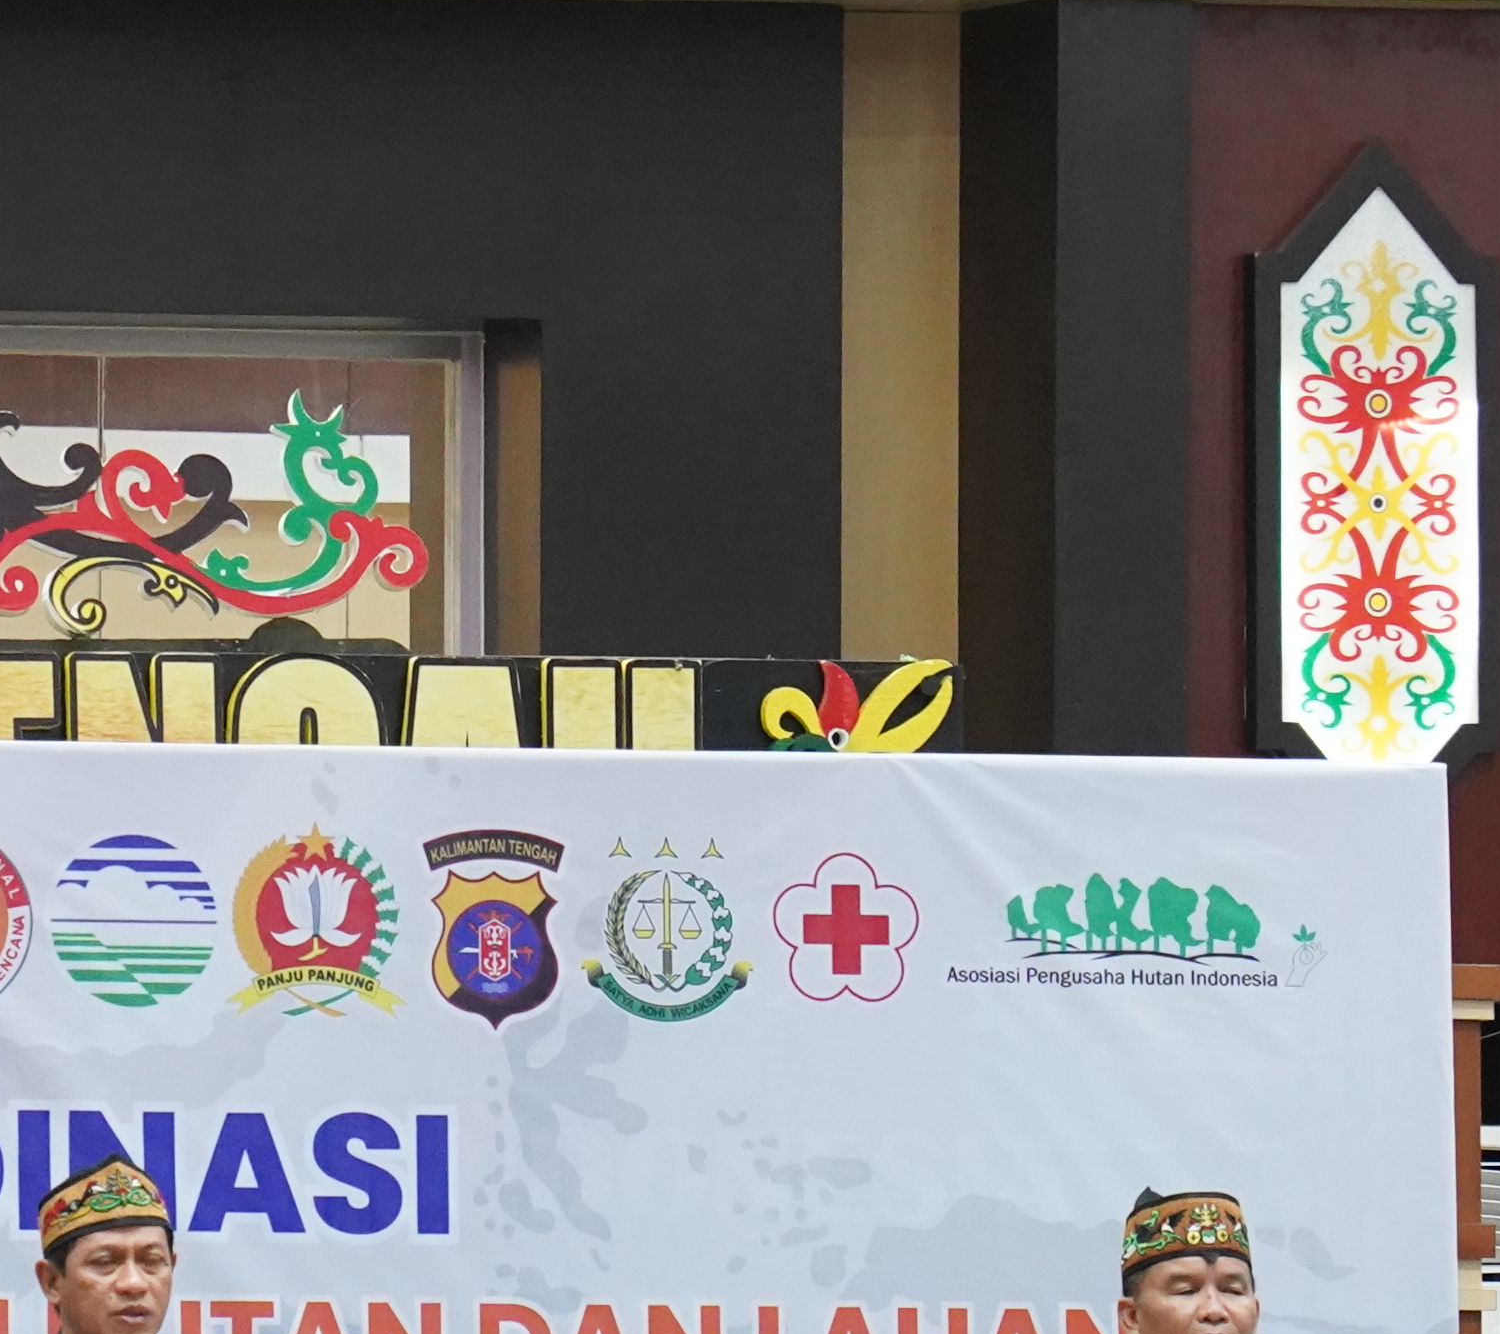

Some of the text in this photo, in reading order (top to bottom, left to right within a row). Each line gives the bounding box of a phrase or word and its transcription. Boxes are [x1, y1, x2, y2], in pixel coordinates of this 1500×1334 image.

[429, 838, 558, 865] KALIMANTAN TENGAH
[257, 969, 375, 992] PANJU PANJUNG
[947, 966, 1278, 989] Asosiasi Pengusaha Hutan Indonesia
[602, 980, 634, 1010] SATYA
